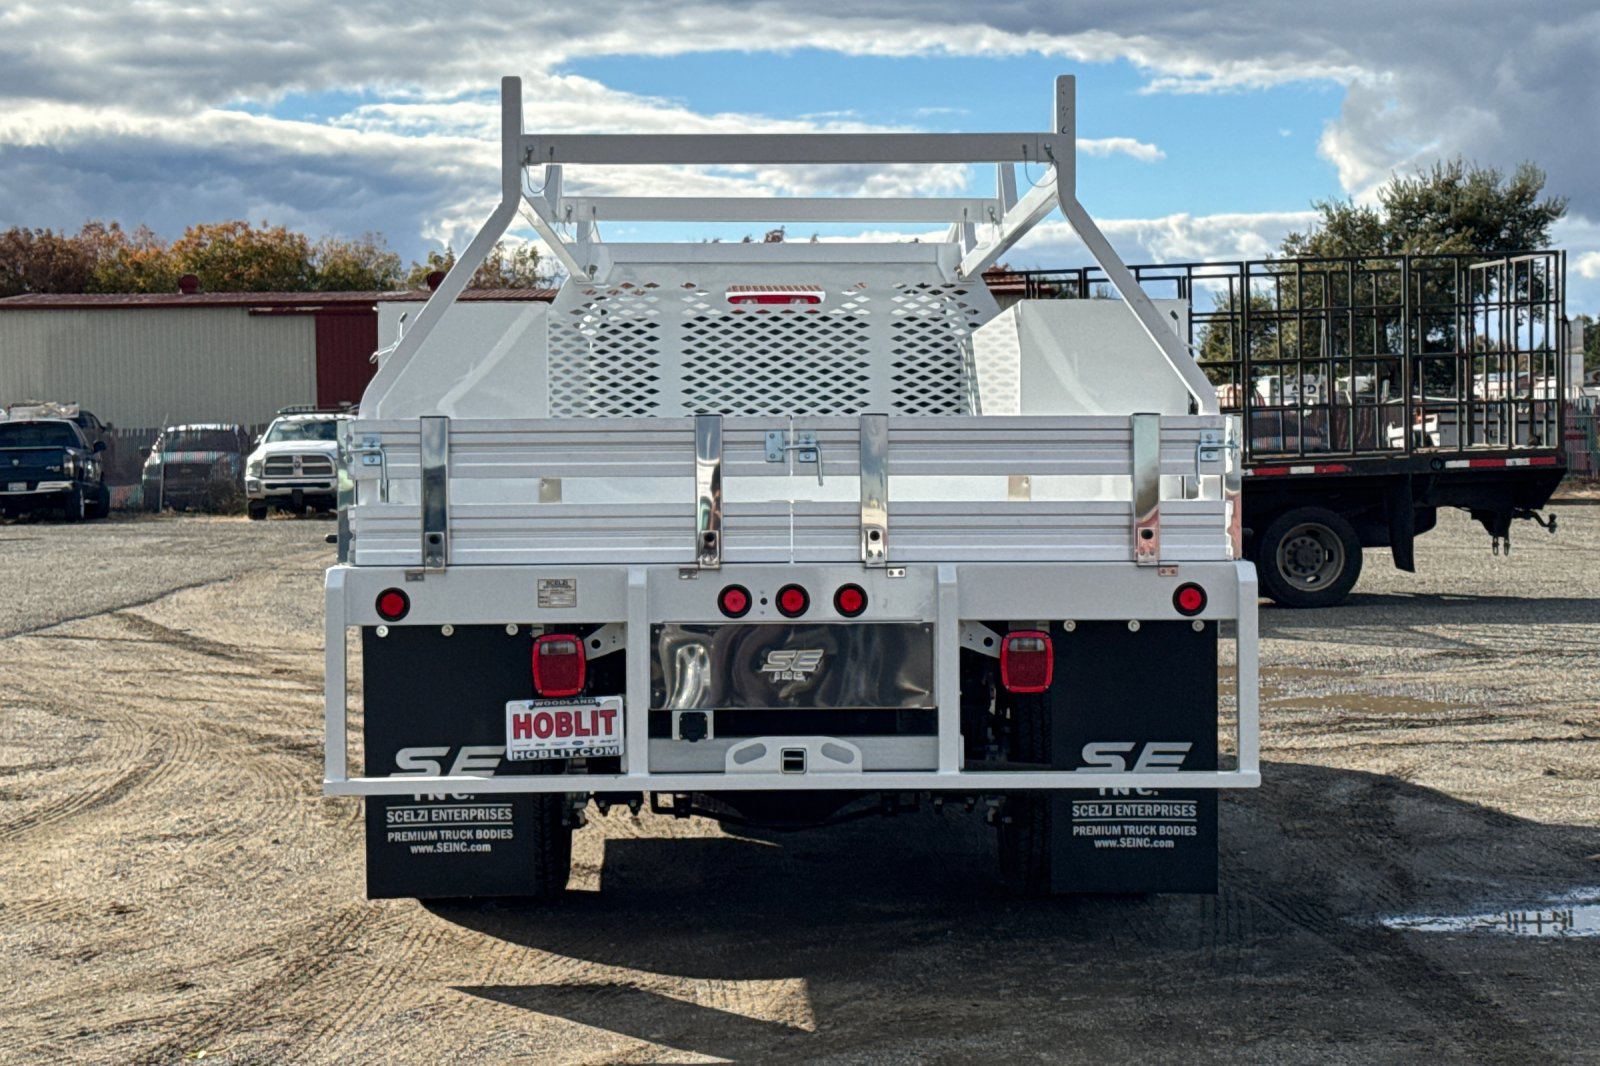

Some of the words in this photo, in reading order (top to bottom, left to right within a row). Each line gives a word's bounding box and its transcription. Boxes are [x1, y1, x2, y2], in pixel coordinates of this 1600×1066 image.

[762, 650, 824, 672] SE
[534, 699, 596, 707] WOODLAND
[513, 709, 617, 740] HOBLIT
[513, 746, 619, 760] HOBLIT.COM
[1075, 742, 1193, 772] SE
[389, 746, 506, 777] SE
[386, 809, 429, 823] SCELZI
[431, 807, 513, 821] ENTERPRISES
[1072, 804, 1113, 817] SCELZI
[1115, 804, 1197, 817] ENTERPRISES
[387, 830, 438, 843] PREMIUM
[440, 829, 474, 841] TRUCK
[475, 828, 514, 840] BODIES
[1072, 825, 1121, 836] PREMIUM
[1123, 825, 1157, 836] TRUCK
[1159, 825, 1197, 836] BODIES
[410, 841, 492, 855] www.SEINC.com
[1094, 837, 1175, 849] www.SEINC.com
